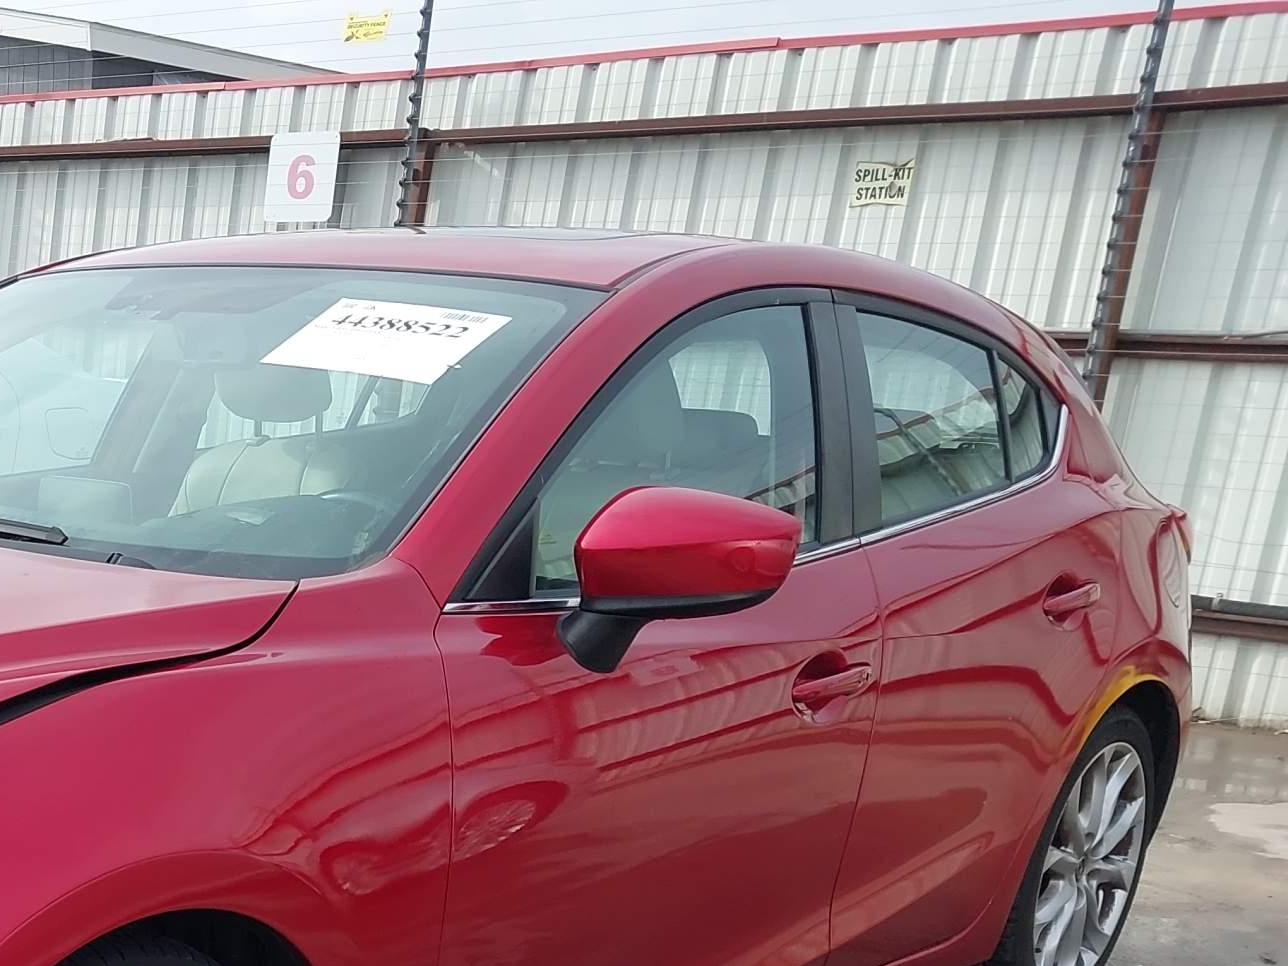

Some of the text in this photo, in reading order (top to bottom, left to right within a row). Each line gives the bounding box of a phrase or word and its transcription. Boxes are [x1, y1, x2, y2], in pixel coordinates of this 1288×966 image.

[287, 154, 316, 199] 6
[854, 167, 914, 182] SPILL-KIT
[855, 185, 906, 200] STATION
[331, 313, 469, 338] 44388522
